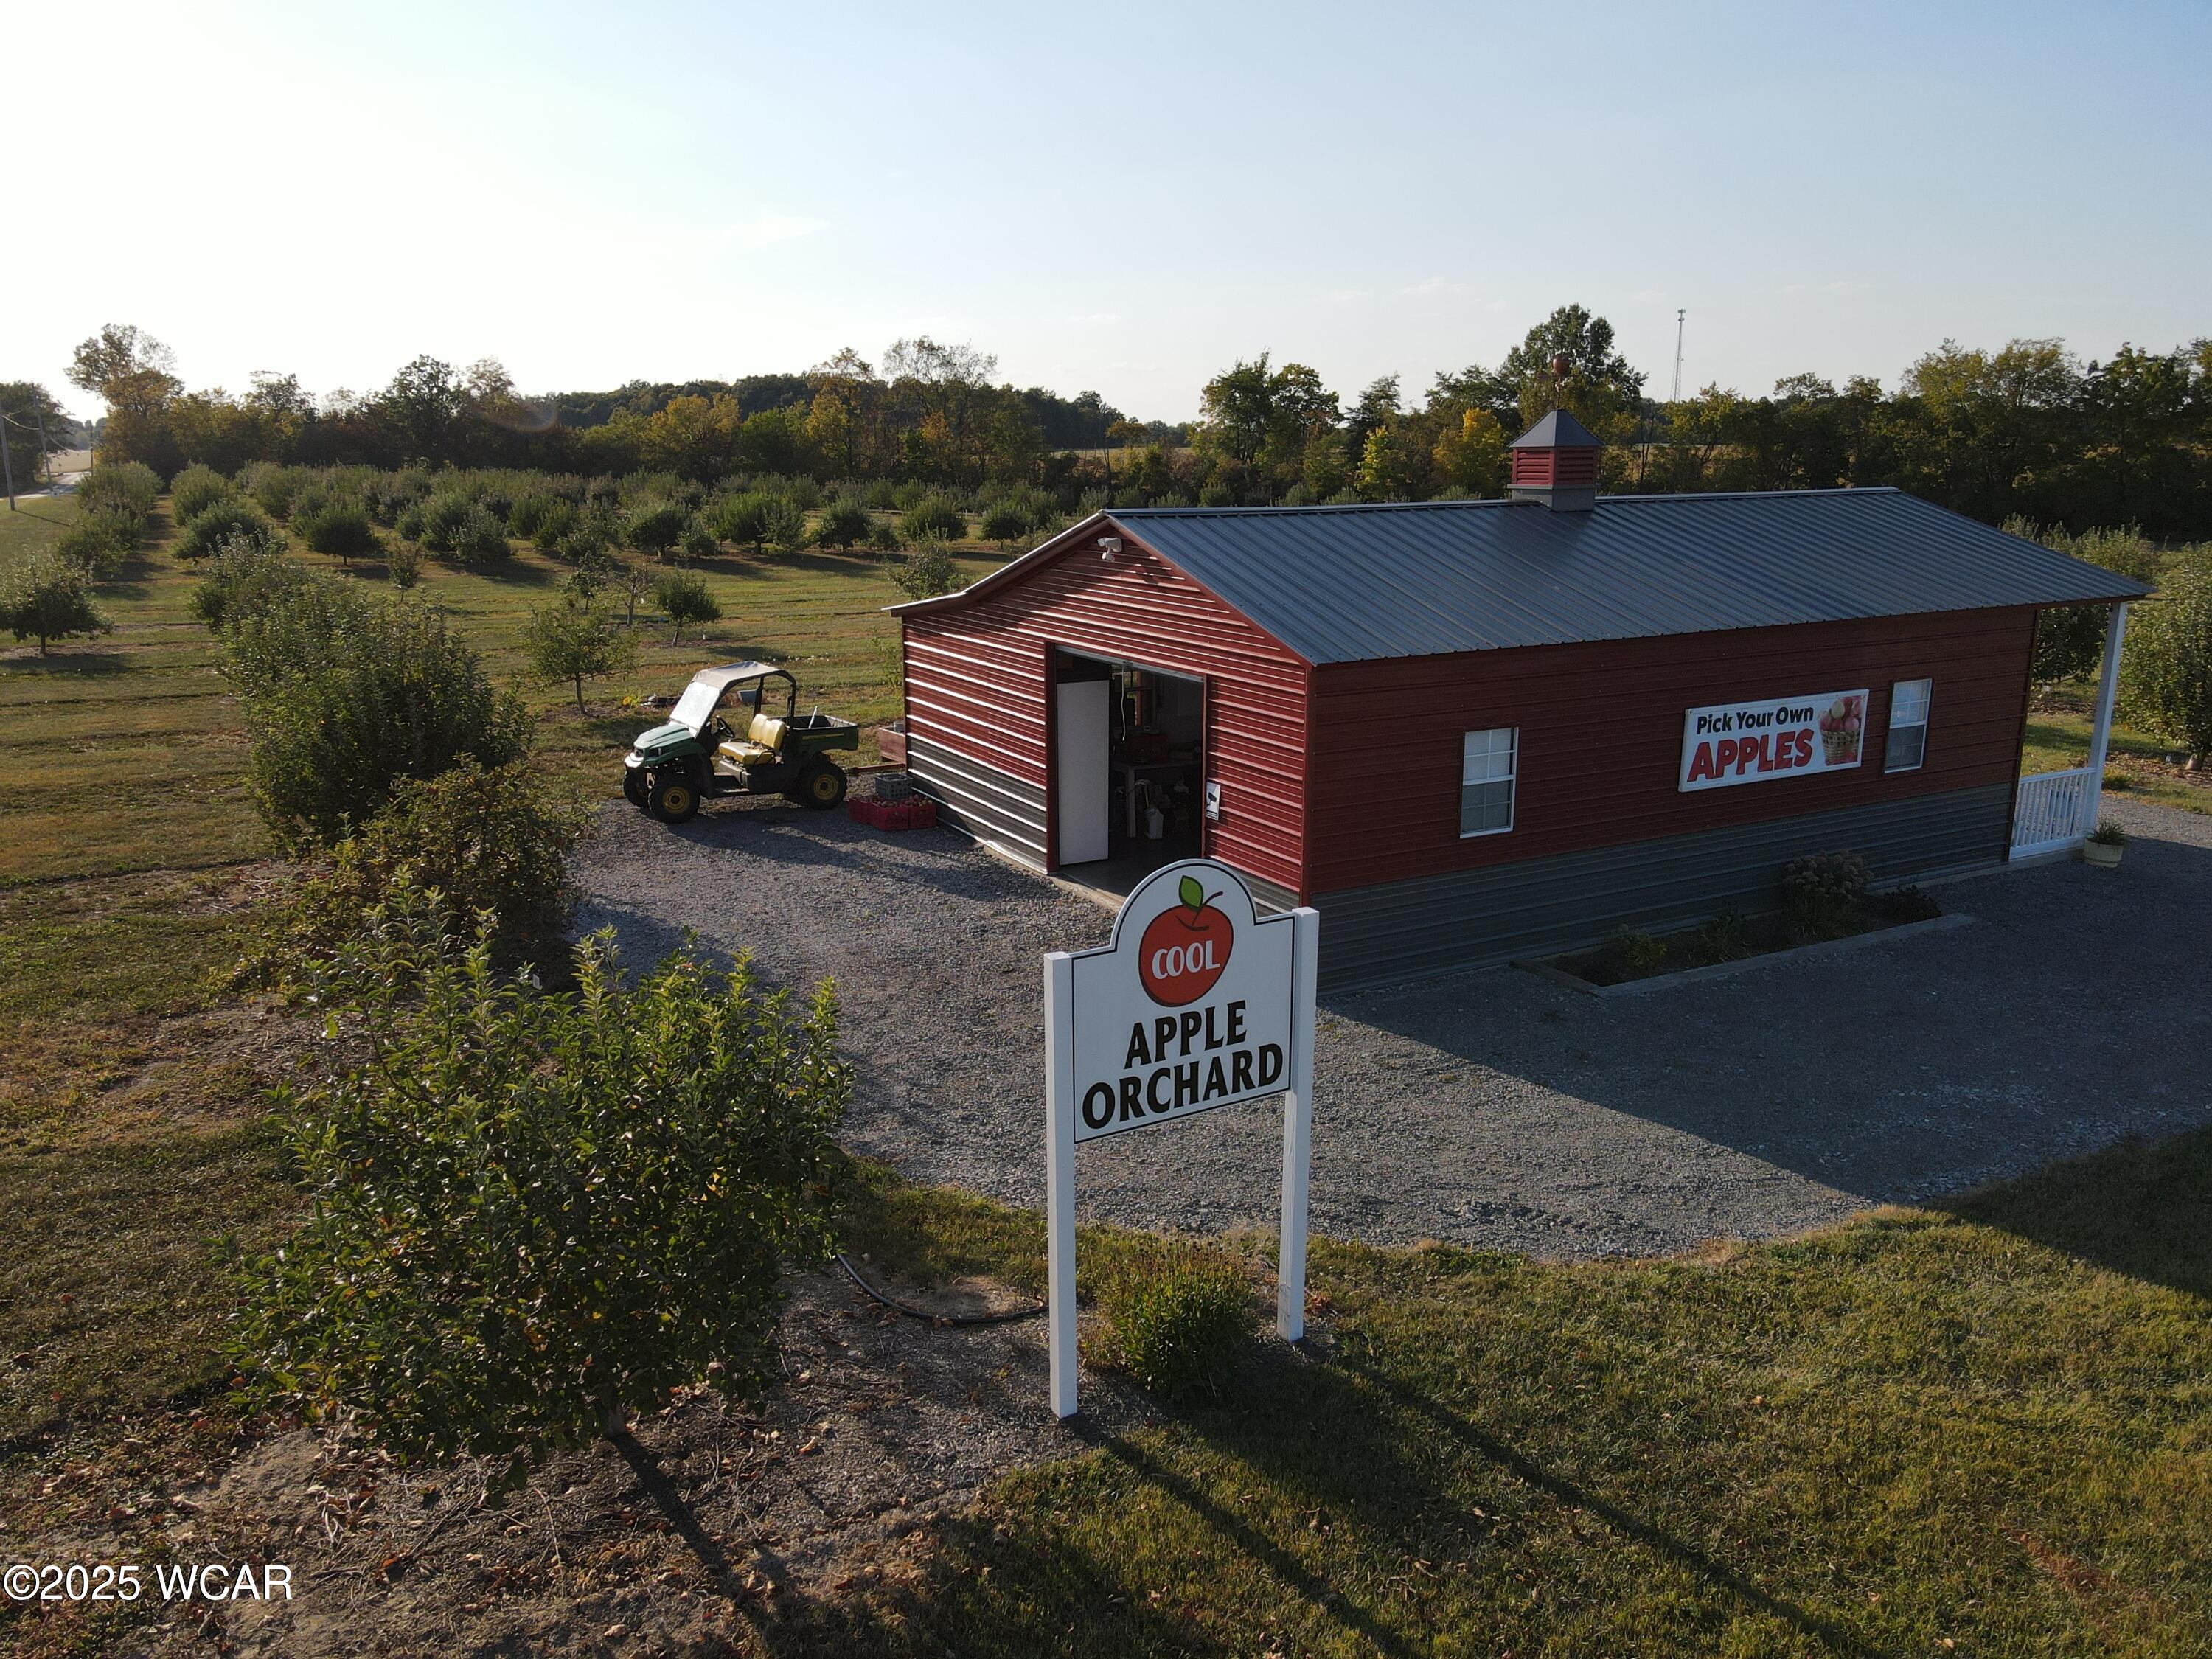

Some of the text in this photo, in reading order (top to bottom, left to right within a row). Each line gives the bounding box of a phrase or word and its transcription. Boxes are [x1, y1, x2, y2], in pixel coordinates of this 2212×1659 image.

[1697, 706, 1814, 734] Pick Your Own
[1687, 728, 1815, 782] APPLES
[1152, 939, 1221, 980] COOL
[1124, 1000, 1248, 1069] APPLE
[1082, 1043, 1284, 1130] ORCHARD
